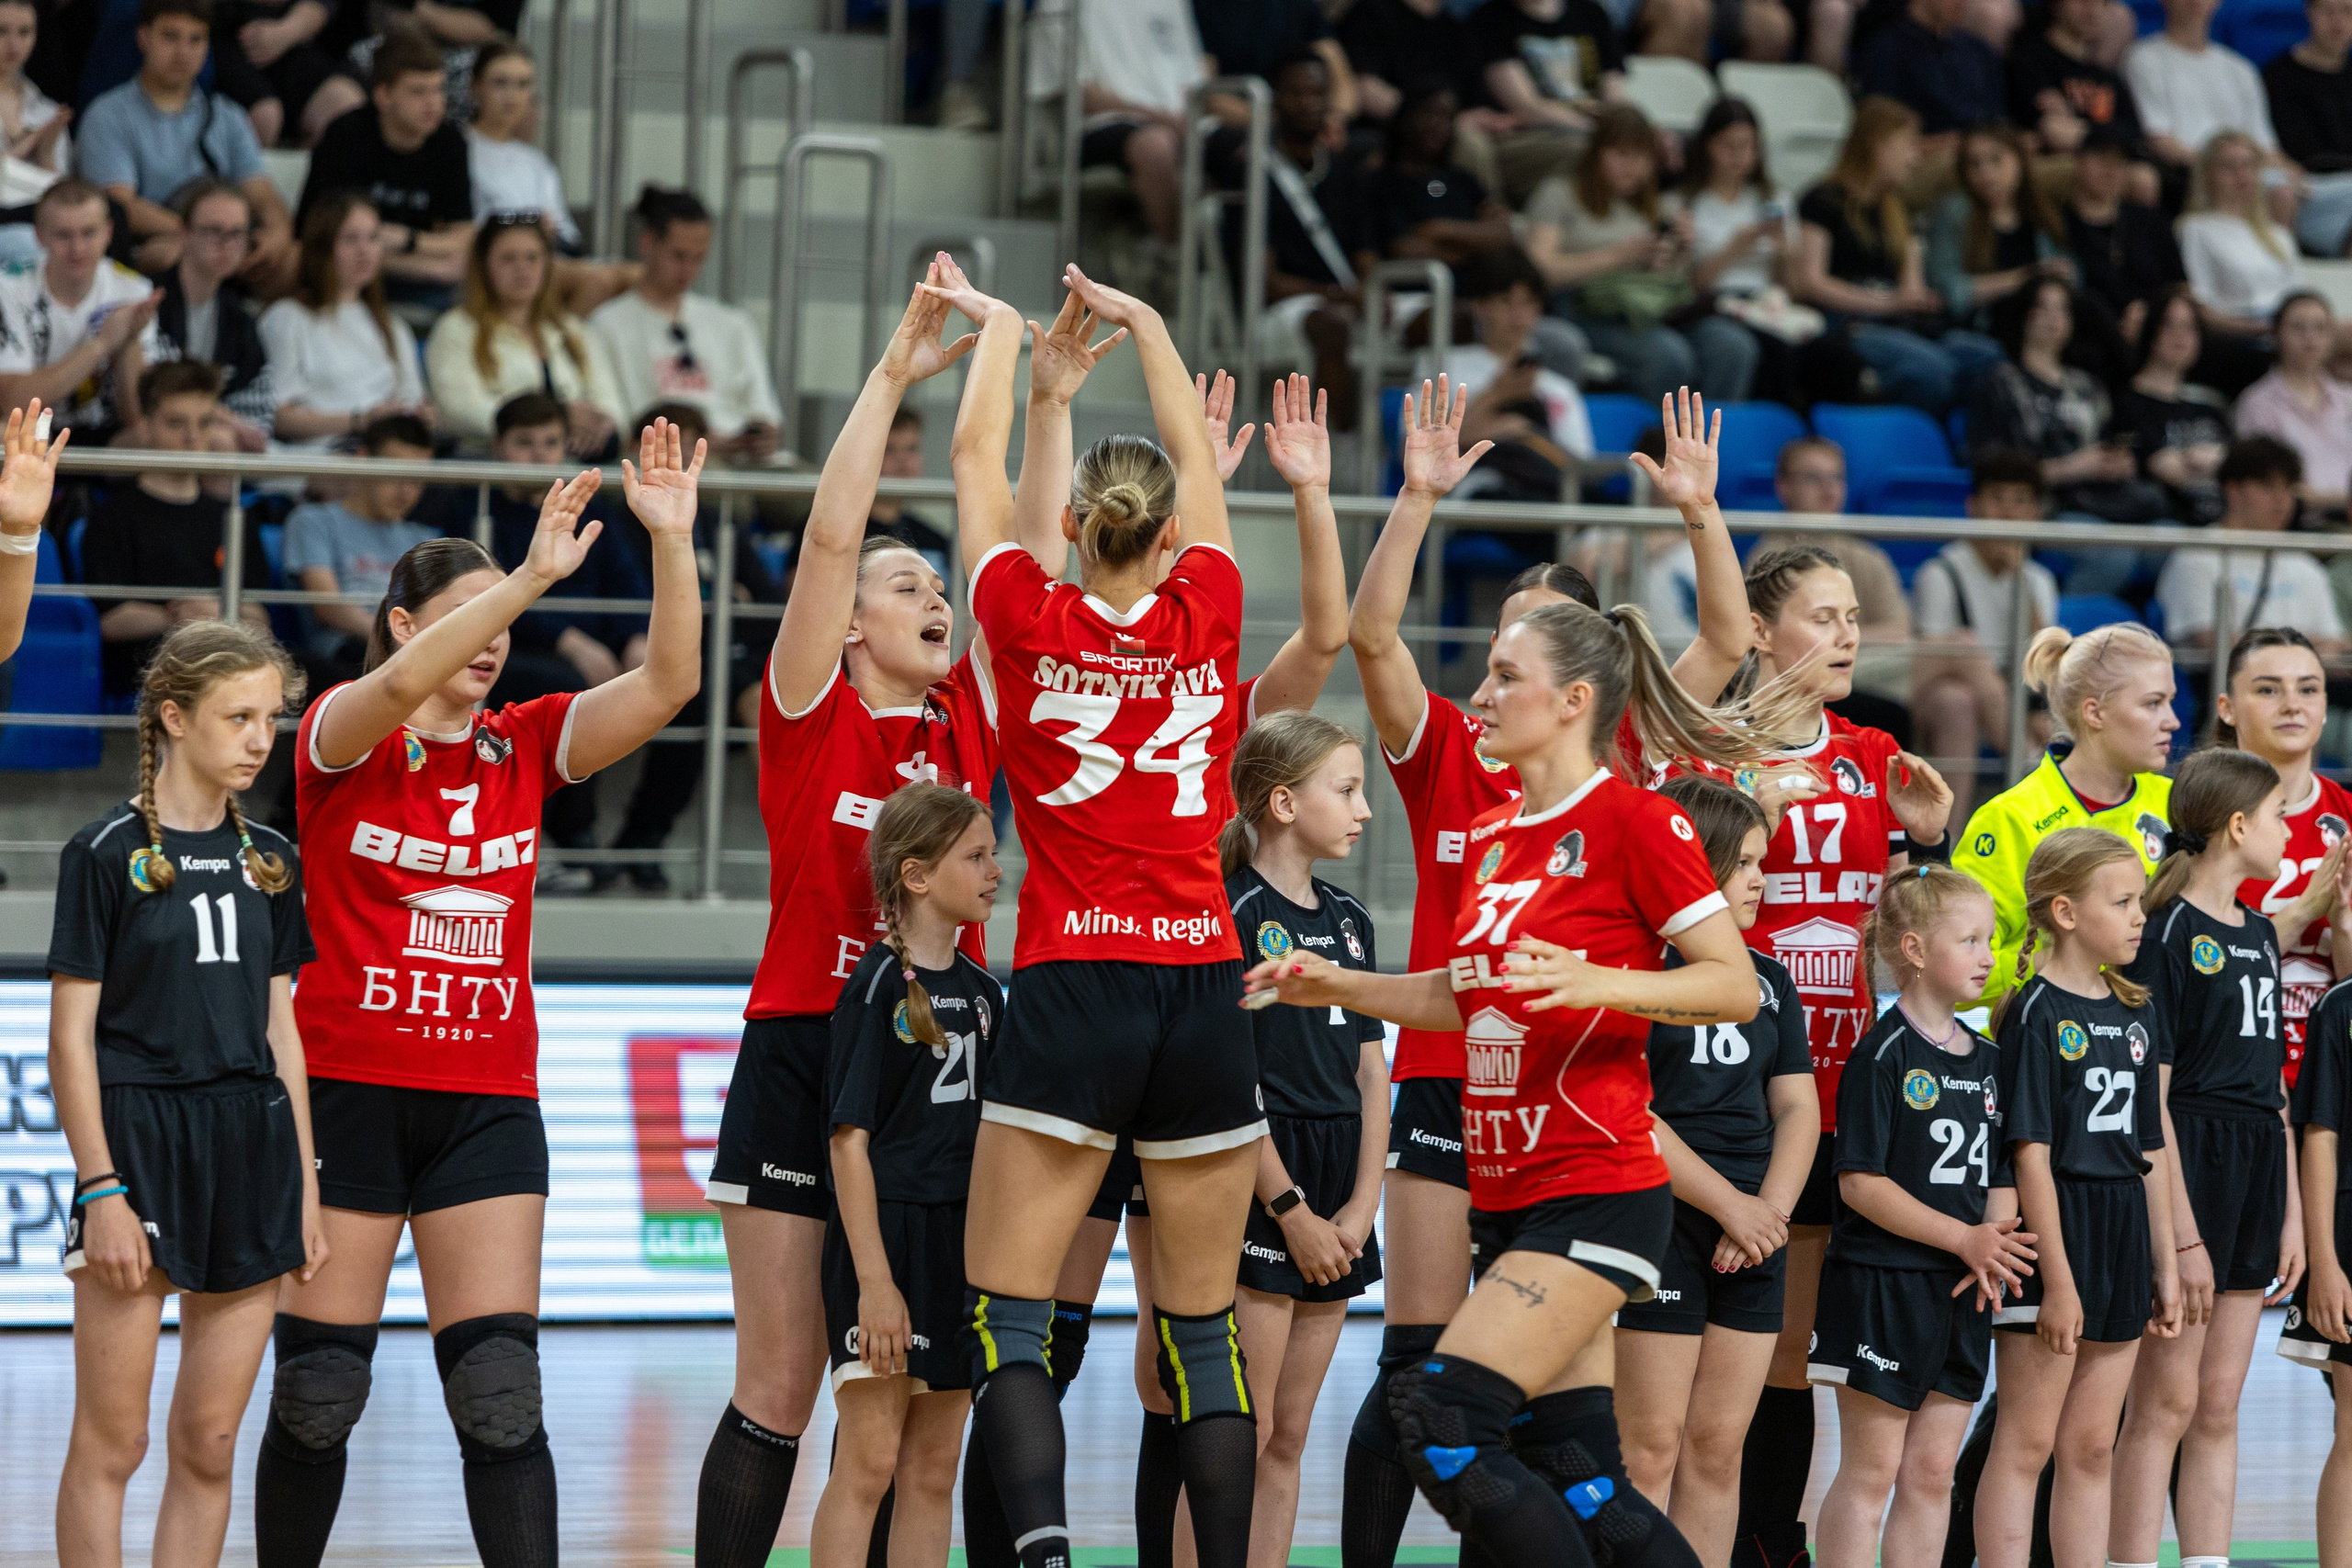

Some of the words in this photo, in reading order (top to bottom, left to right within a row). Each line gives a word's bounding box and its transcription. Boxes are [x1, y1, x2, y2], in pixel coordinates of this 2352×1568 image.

[1080, 650, 1177, 672] SPORTIX
[1029, 691, 1224, 816] 34
[439, 783, 480, 837] 7
[2032, 805, 2069, 834] Kempa
[1786, 802, 1847, 864] 17
[178, 855, 231, 874] Kempa
[1456, 878, 1543, 947] 37
[189, 892, 241, 964] 11
[1296, 932, 1336, 948] Kempa
[2227, 944, 2262, 963] Kempa
[358, 965, 518, 1021] БНТУ
[930, 995, 968, 1011] Kempa
[2238, 974, 2277, 1041] 14
[422, 1026, 474, 1042] 1920
[1690, 1021, 1751, 1066] 18
[2087, 1022, 2123, 1040] Kempa
[930, 1031, 977, 1104] 21
[1940, 1075, 1982, 1094] Kempa
[2085, 1066, 2136, 1134] 27
[1409, 1127, 1463, 1153] Kempa
[1928, 1118, 1989, 1188] 24
[761, 1162, 817, 1187] Kempa
[1241, 1239, 1287, 1264] Kempa
[1054, 1309, 1083, 1322] empa
[1856, 1343, 1900, 1371] Kempa
